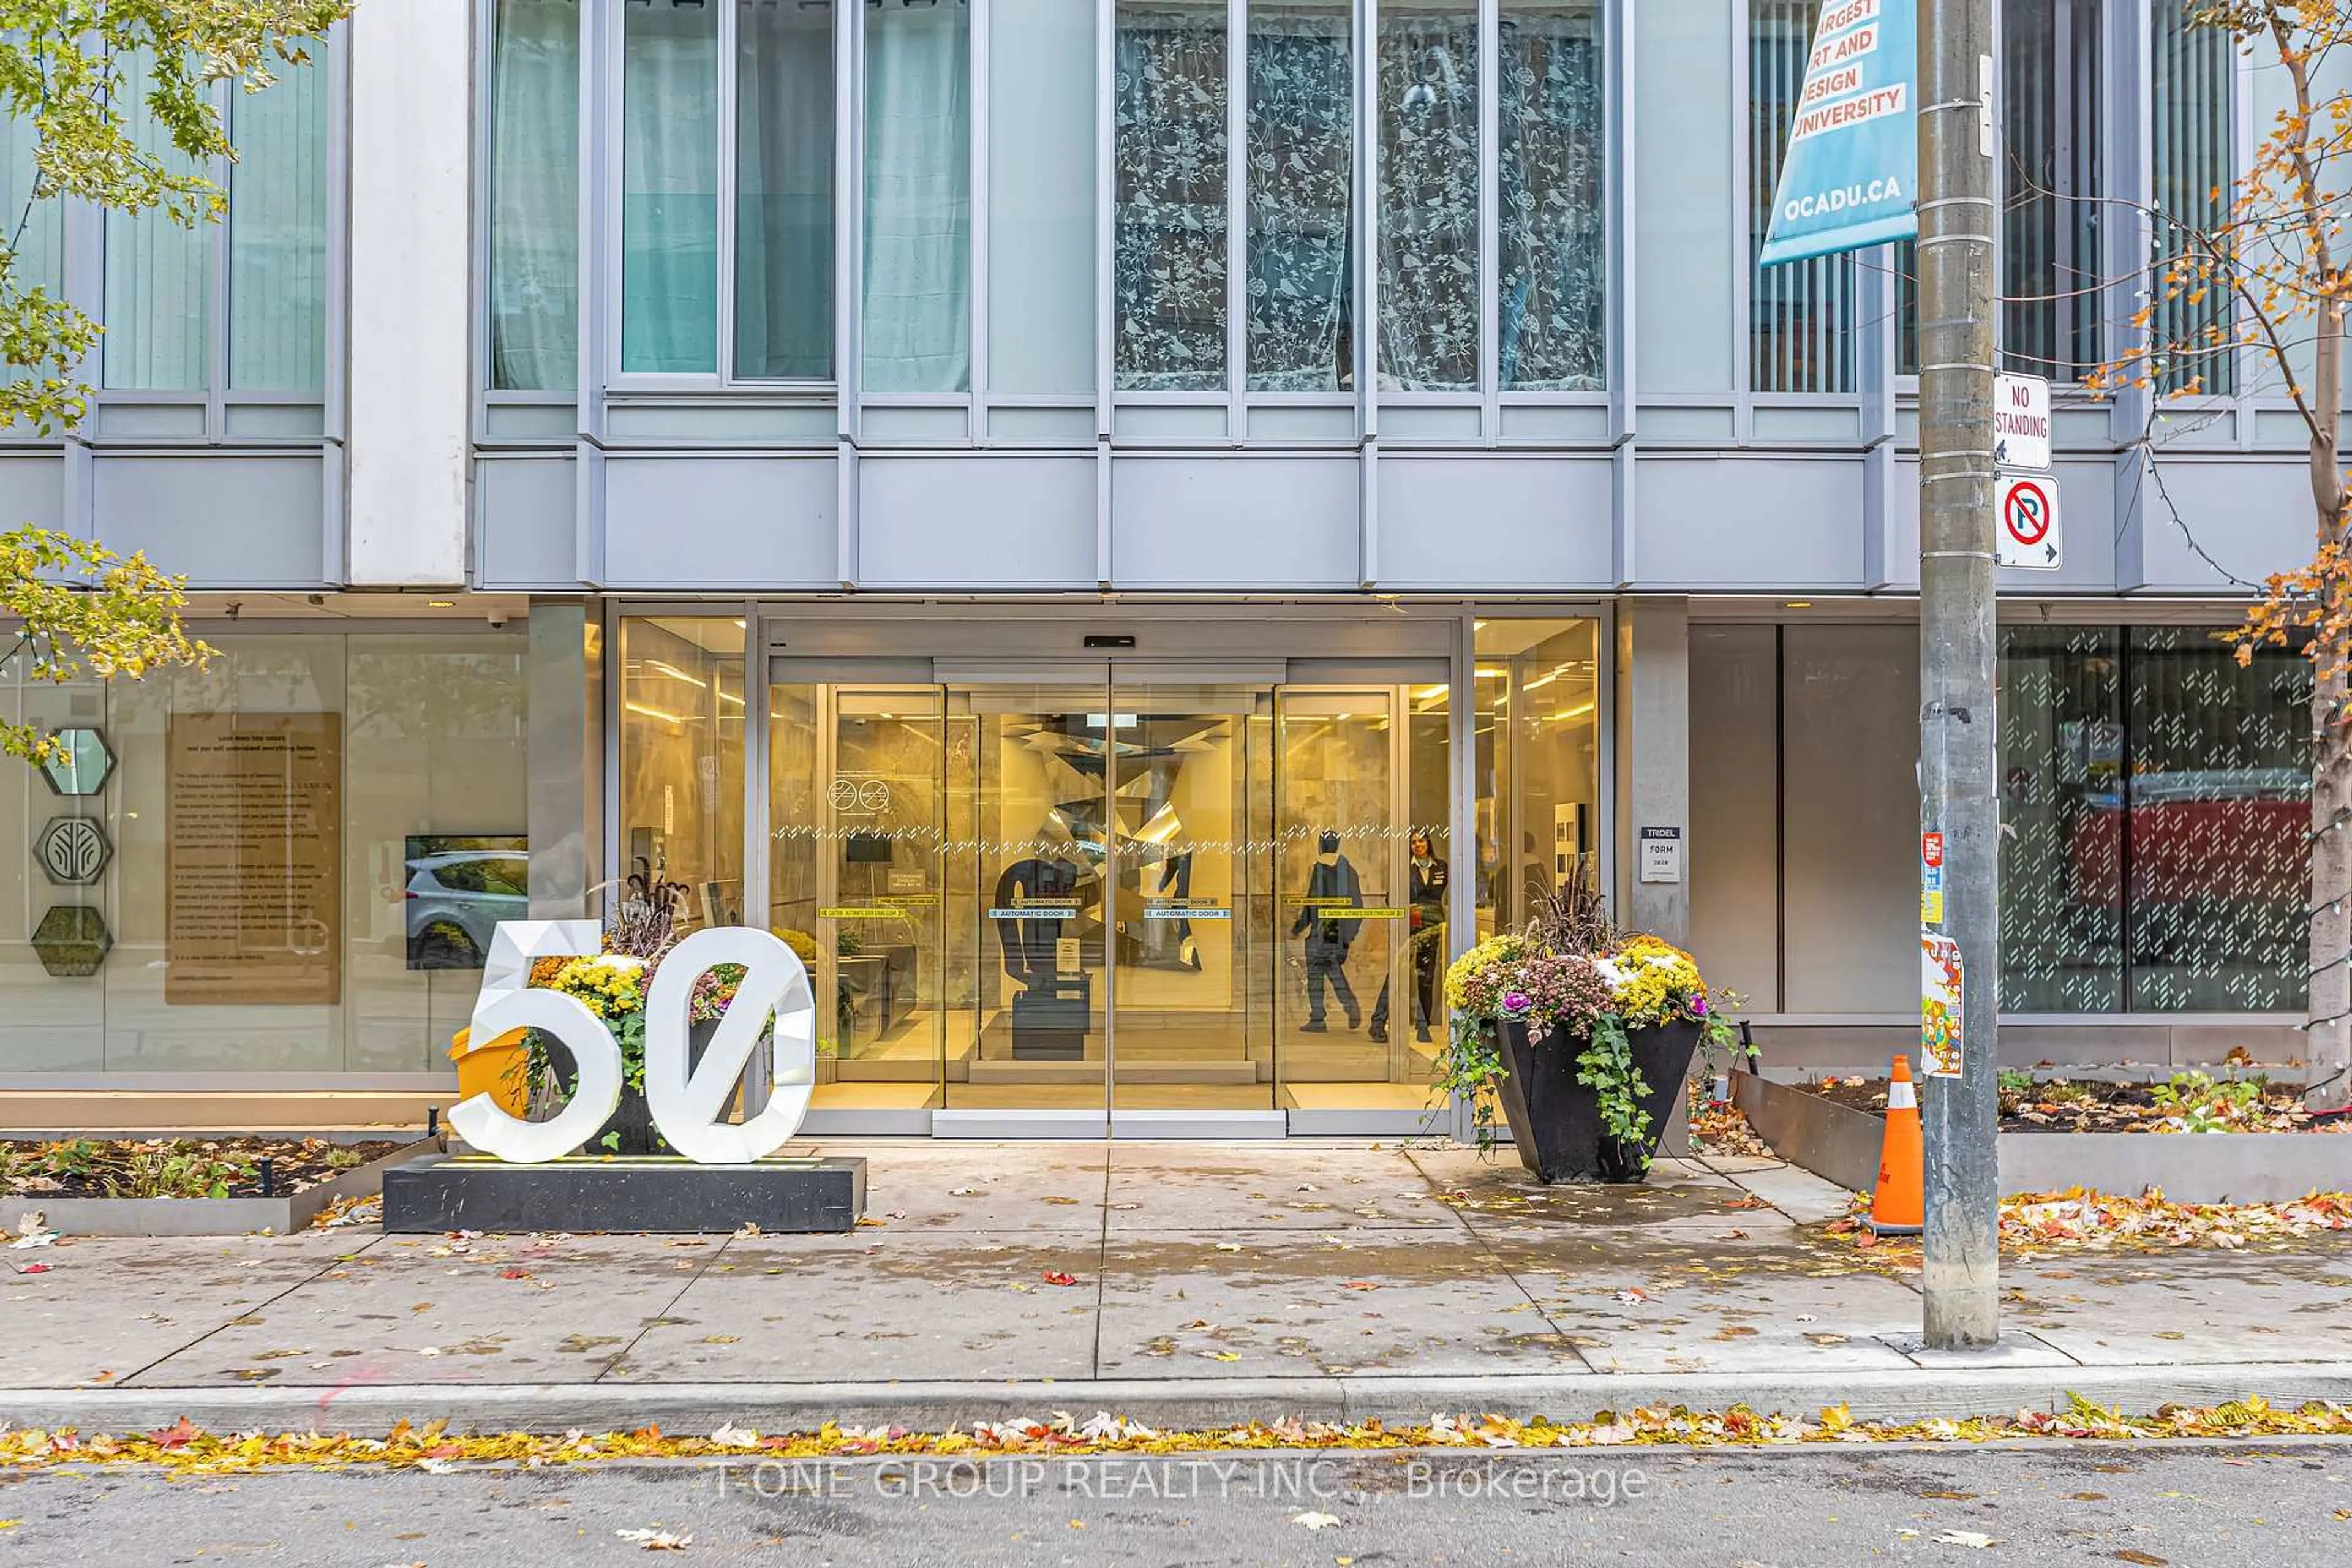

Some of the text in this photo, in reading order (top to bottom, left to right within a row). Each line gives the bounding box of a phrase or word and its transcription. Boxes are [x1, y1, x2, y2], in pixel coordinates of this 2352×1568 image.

[1835, 31, 1872, 59] AND
[1785, 176, 1901, 221] OCADU.CA
[2012, 385, 2029, 407] NO
[1996, 412, 2047, 438] STANDING
[447, 919, 816, 1164] 50
